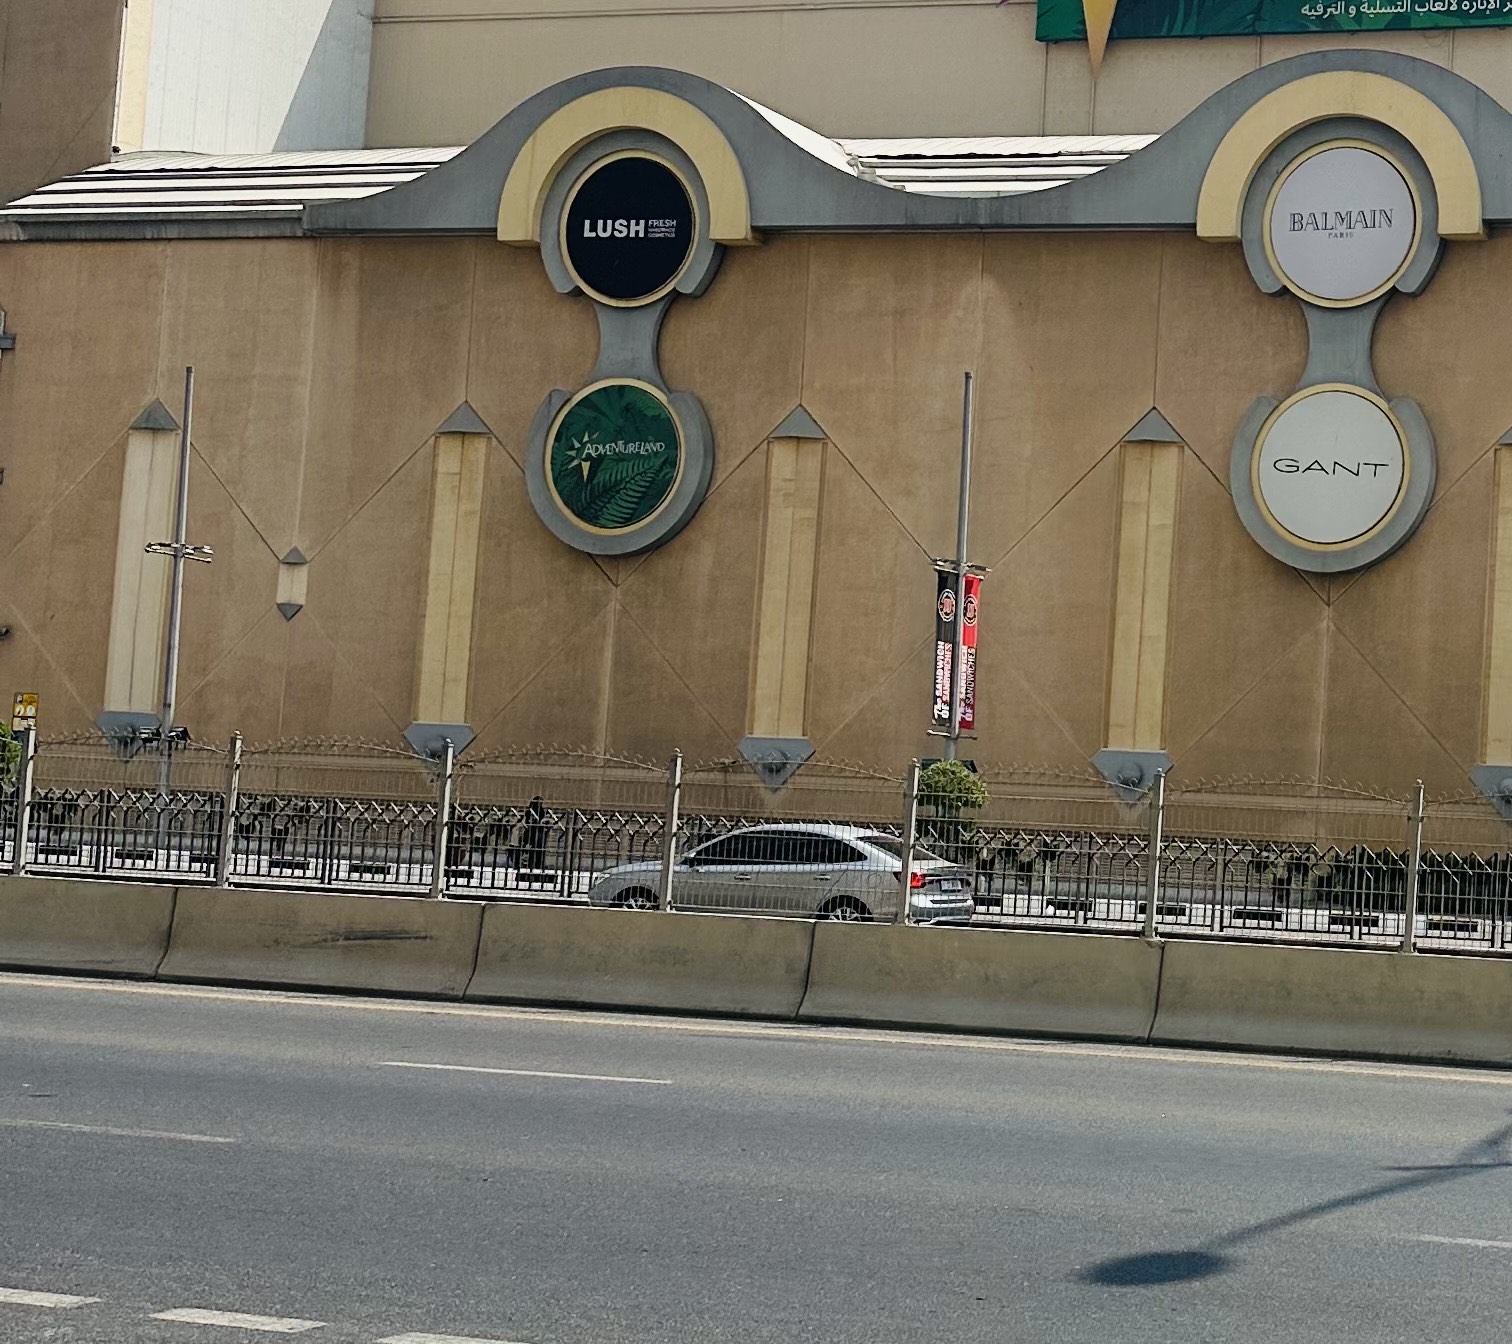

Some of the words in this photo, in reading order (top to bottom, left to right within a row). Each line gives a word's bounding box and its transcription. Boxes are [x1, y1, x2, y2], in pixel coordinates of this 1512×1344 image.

[1300, 0, 1345, 19] الترفيه
[583, 219, 646, 237] LUSH
[1289, 208, 1394, 232] BALMAIN
[1327, 231, 1354, 239] PARIS
[581, 440, 666, 459] ADVENTURELAND
[1273, 458, 1390, 479] GANT
[935, 640, 945, 697] SANDWICH
